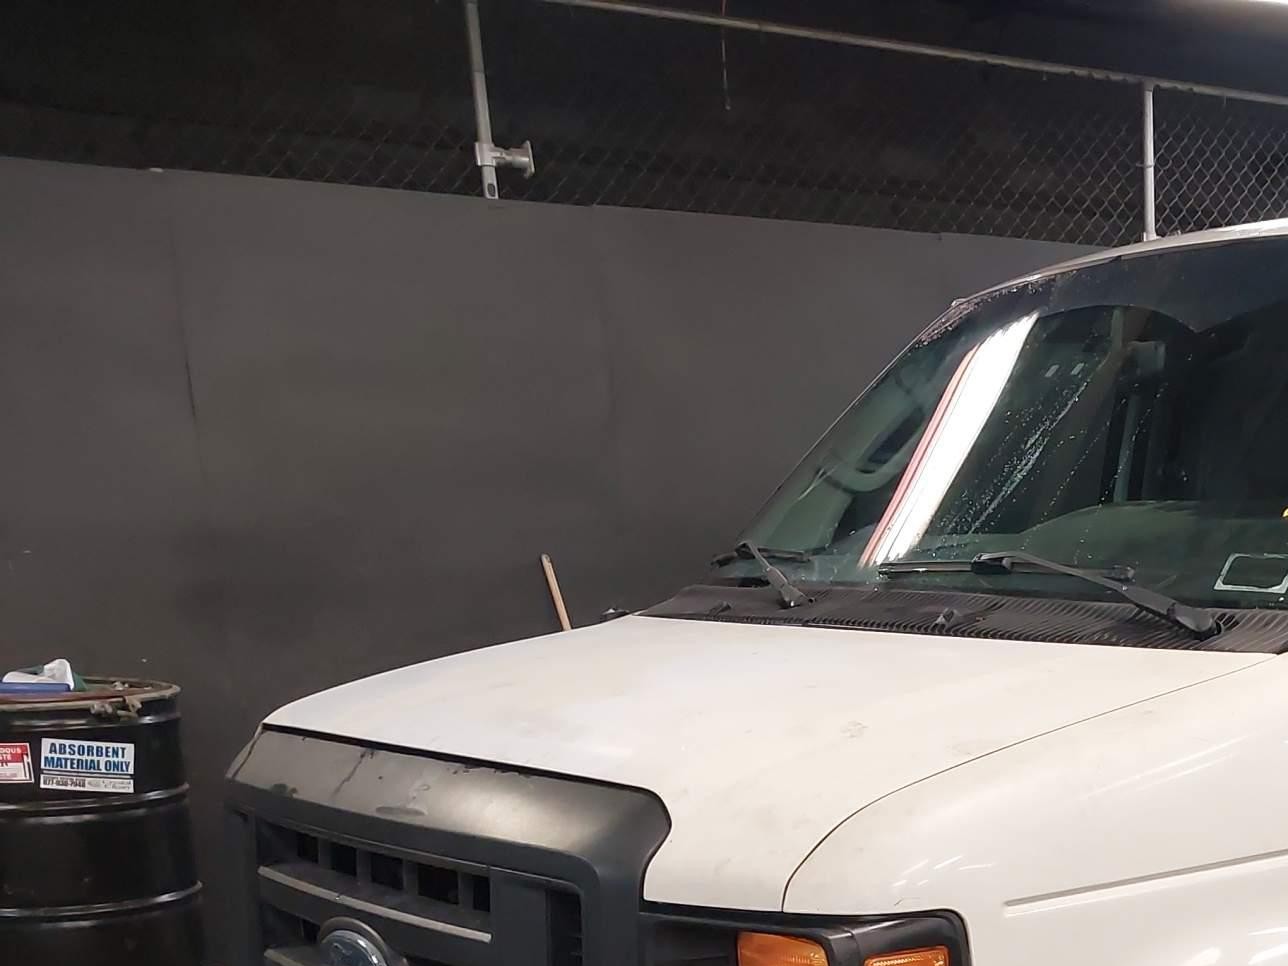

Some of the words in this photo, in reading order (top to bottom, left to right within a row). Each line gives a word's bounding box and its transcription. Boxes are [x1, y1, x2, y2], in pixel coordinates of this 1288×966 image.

[48, 742, 127, 759] ABSORBENT
[43, 756, 102, 771] MATERIAL
[104, 760, 131, 773] ONLY
